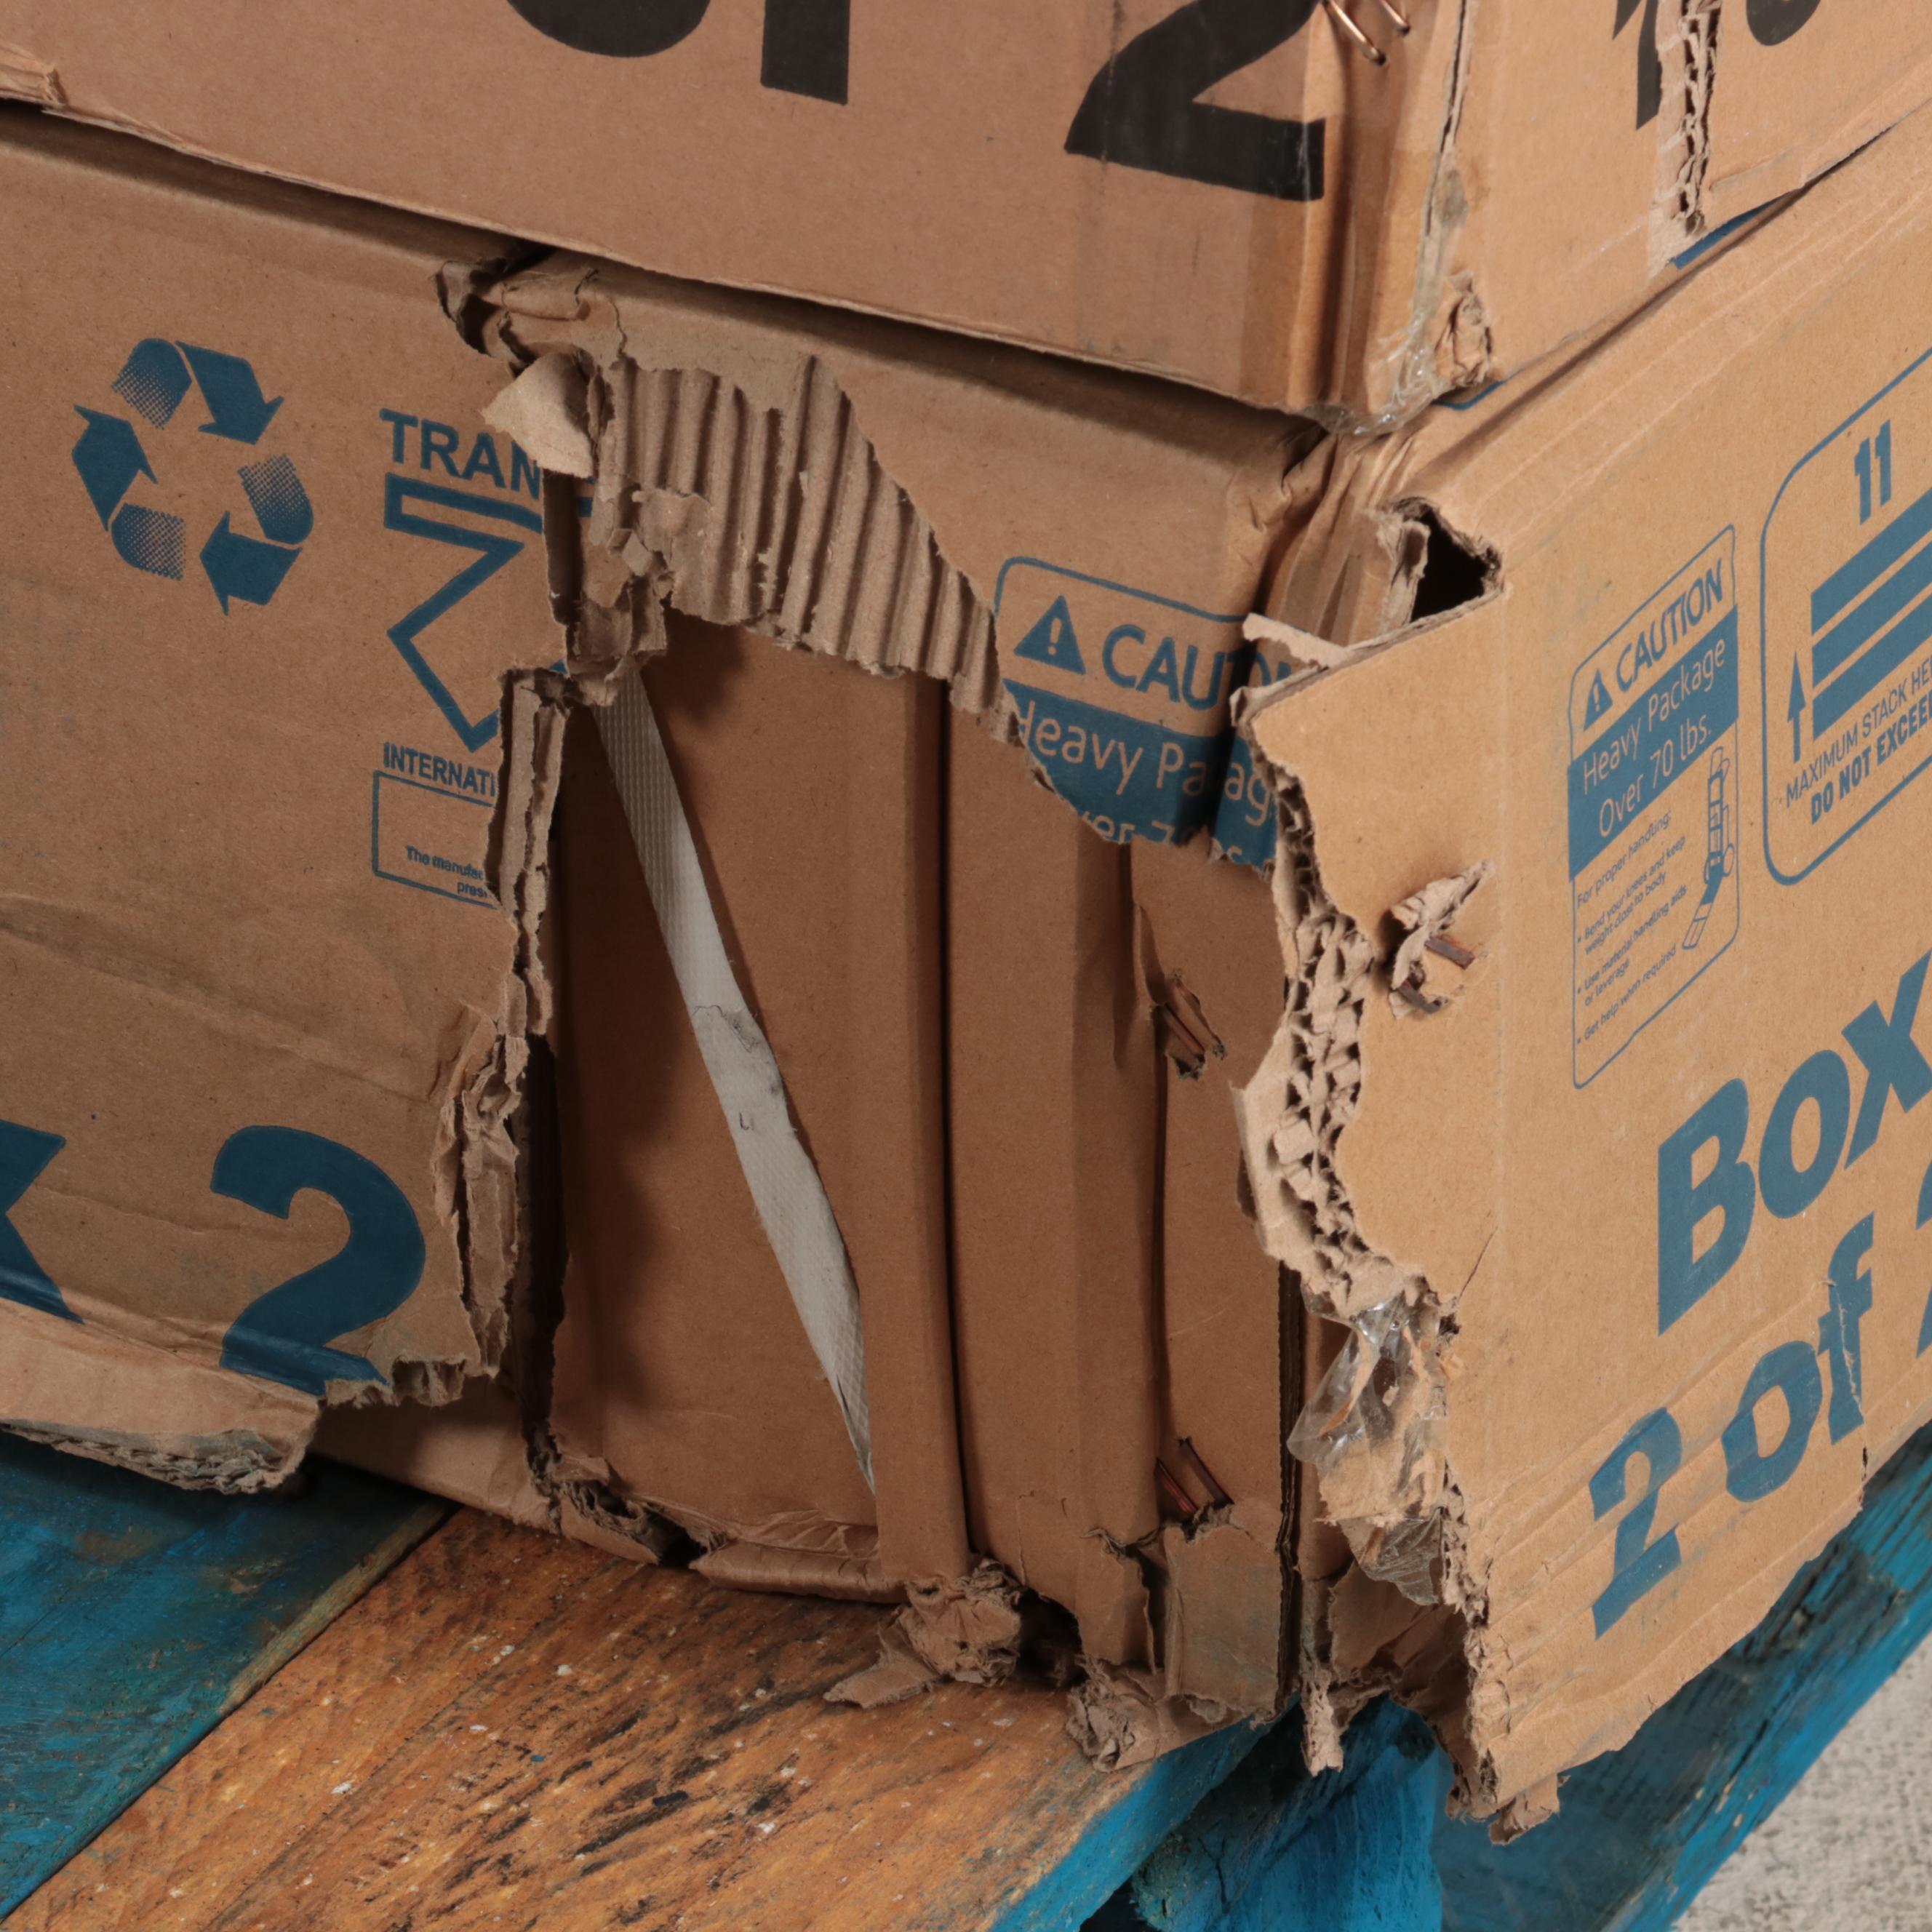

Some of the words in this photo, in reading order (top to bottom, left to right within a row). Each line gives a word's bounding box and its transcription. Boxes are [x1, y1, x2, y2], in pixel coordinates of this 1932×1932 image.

[1853, 420, 1891, 524] 11
[1616, 559, 1724, 693] CAUTION
[1583, 716, 1642, 796] Heavy
[1648, 639, 1725, 733] Package
[1787, 722, 1858, 808] MAXIMUM
[1862, 679, 1907, 738] STACK
[1598, 773, 1644, 839] Over
[1650, 742, 1674, 789] 70
[1680, 713, 1712, 762] lbs.
[1811, 781, 1835, 826] DO
[1840, 744, 1872, 800] NOT
[405, 845, 430, 866] The
[1578, 887, 1594, 909] For
[1595, 858, 1626, 893] proper
[1628, 810, 1672, 858] handling:
[1585, 909, 1606, 938] Bend
[1606, 894, 1625, 924] your
[1626, 872, 1648, 901] knees
[1649, 855, 1665, 880] and
[1666, 836, 1686, 865] keep
[1584, 971, 1600, 991] Use
[1601, 938, 1633, 975] material
[1632, 905, 1669, 941] handling
[1670, 883, 1688, 906] aids
[1585, 922, 1613, 956] weight
[1614, 901, 1634, 931] close
[1645, 871, 1666, 898] body
[1584, 991, 1594, 1007] or
[1595, 959, 1631, 997] leverage
[1584, 1018, 1600, 1041] Get
[1600, 1000, 1619, 1026] help
[1619, 978, 1642, 1007] when
[1642, 943, 1677, 982] required
[1658, 950, 1932, 1336] Box
[210, 1125, 426, 1396] 2
[1589, 1405, 1682, 1640] 2
[1721, 1213, 1874, 1503] of
